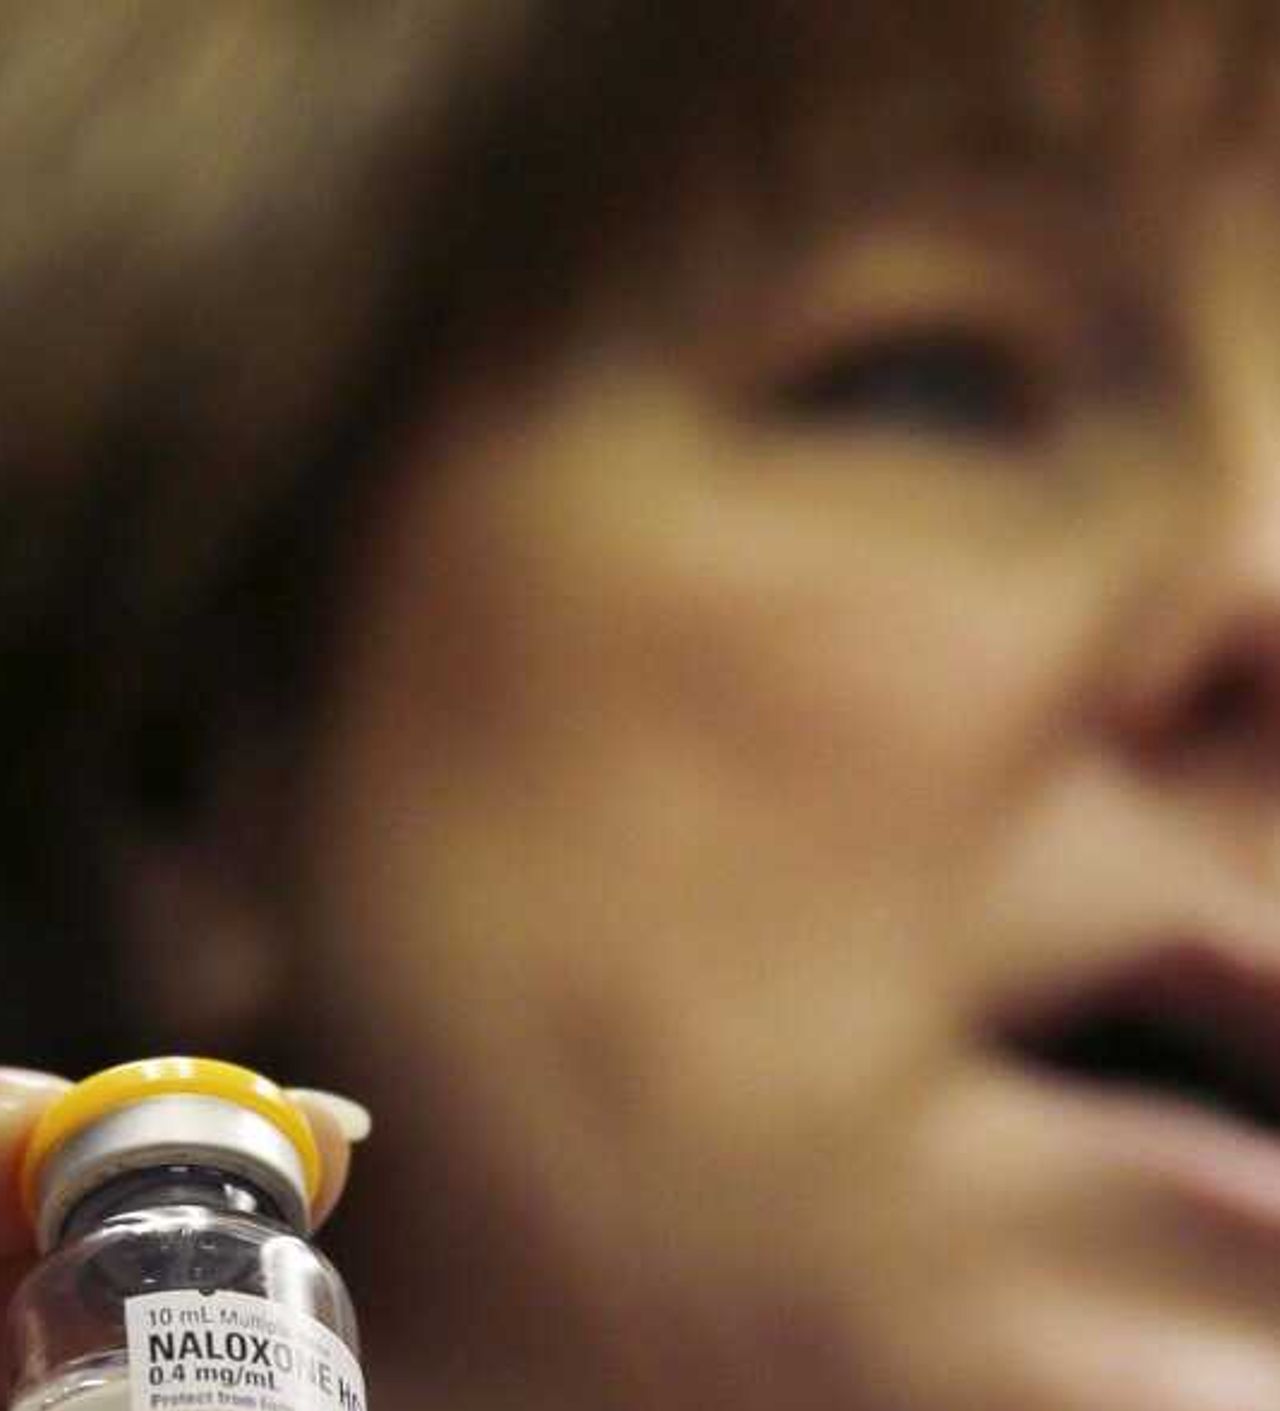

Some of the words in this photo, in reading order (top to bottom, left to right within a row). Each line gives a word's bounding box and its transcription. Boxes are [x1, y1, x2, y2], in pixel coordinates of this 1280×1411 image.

[149, 1307, 172, 1326] 10
[180, 1306, 214, 1325] mL
[149, 1364, 186, 1386] 0.4
[195, 1367, 281, 1391] mg/mL
